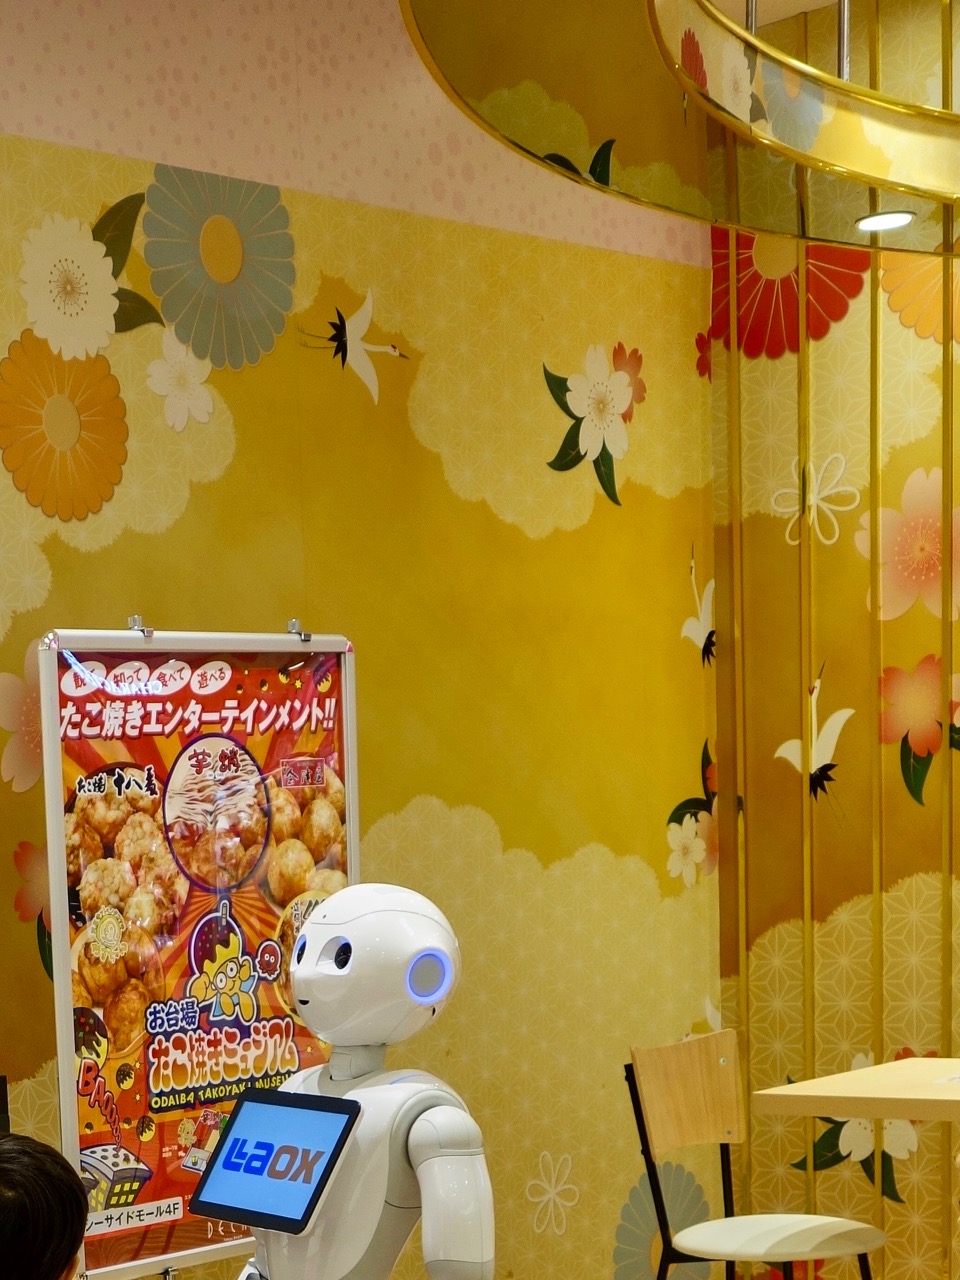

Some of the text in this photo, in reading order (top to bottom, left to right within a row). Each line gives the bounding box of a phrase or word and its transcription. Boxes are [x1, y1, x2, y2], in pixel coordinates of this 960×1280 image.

[156, 665, 186, 687] 食べて
[196, 666, 227, 690] 遊べる
[60, 697, 336, 738] たこ焼きエンターテインメント!!
[148, 1001, 199, 1032] お台場
[151, 1091, 195, 1109] ODAIBA
